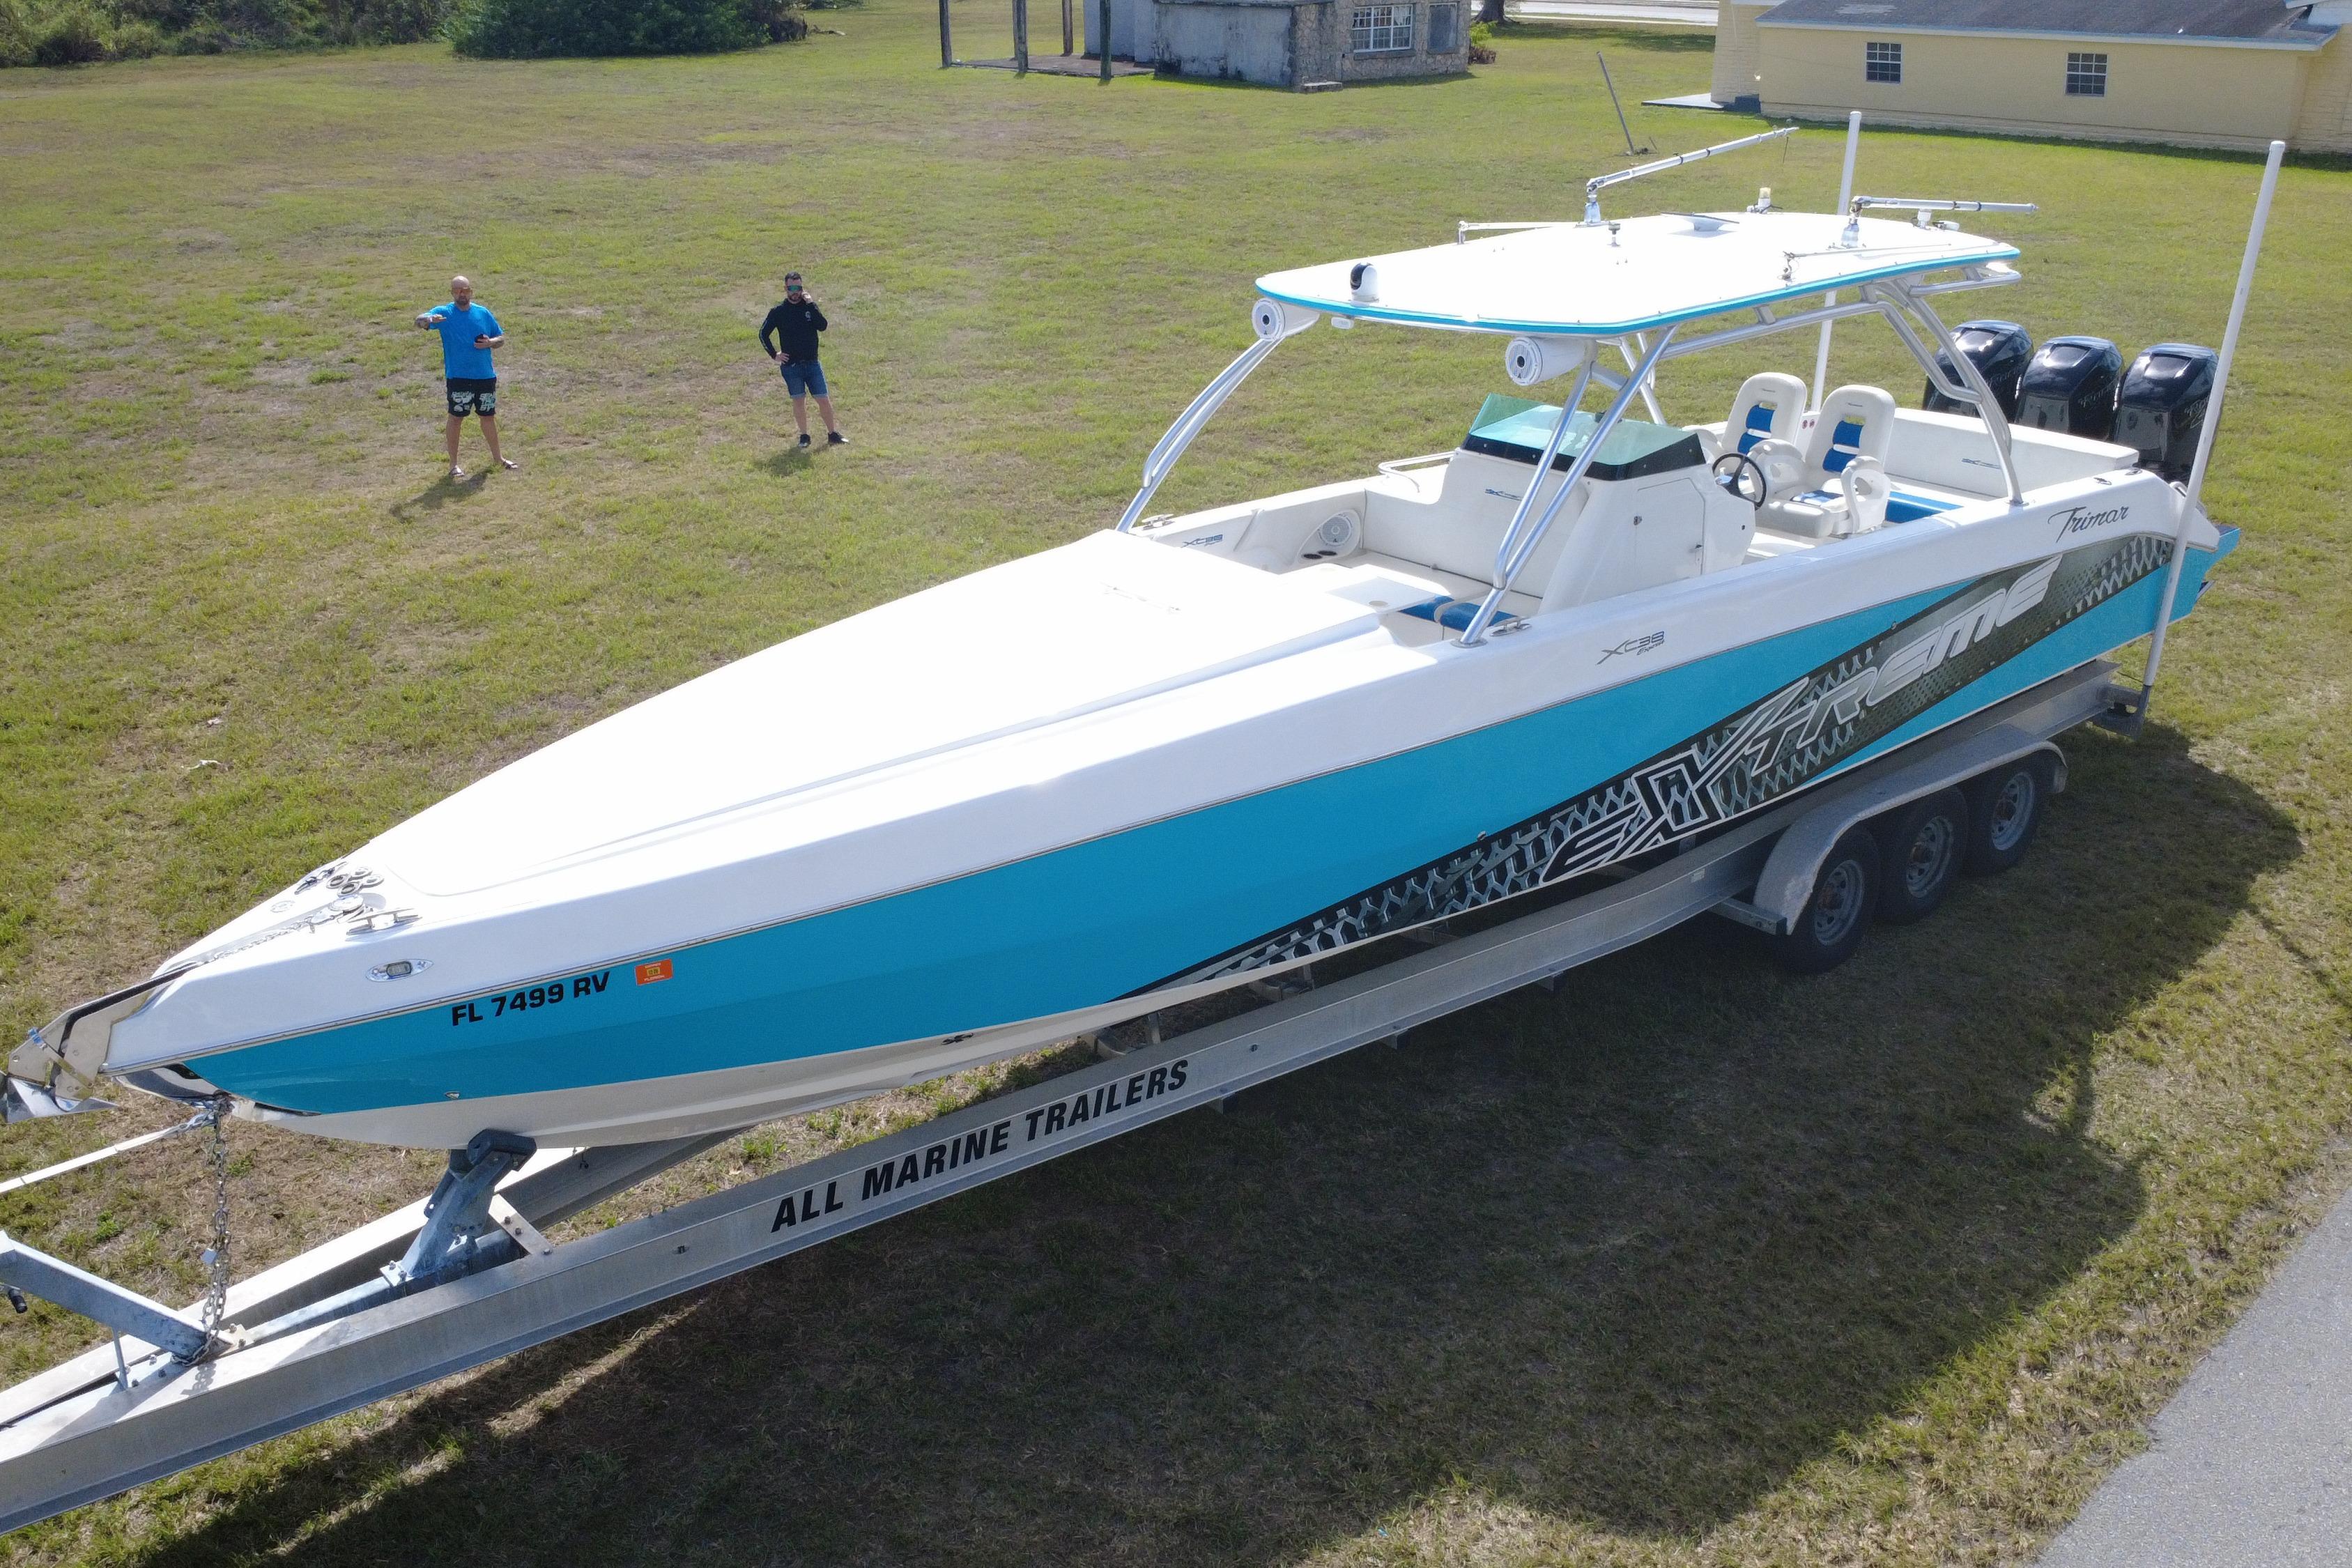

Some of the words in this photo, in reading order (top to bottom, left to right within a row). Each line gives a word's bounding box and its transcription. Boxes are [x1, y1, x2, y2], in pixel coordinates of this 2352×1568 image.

[2047, 505, 2129, 543] Trimar
[1597, 630, 1665, 665] XC38
[451, 1003, 484, 1027] FL
[491, 982, 564, 1017] 7499
[573, 971, 610, 999] RV
[770, 1181, 844, 1233] ALL
[861, 1121, 1011, 1202] MARINE
[1026, 1059, 1189, 1142] TRAILERS
